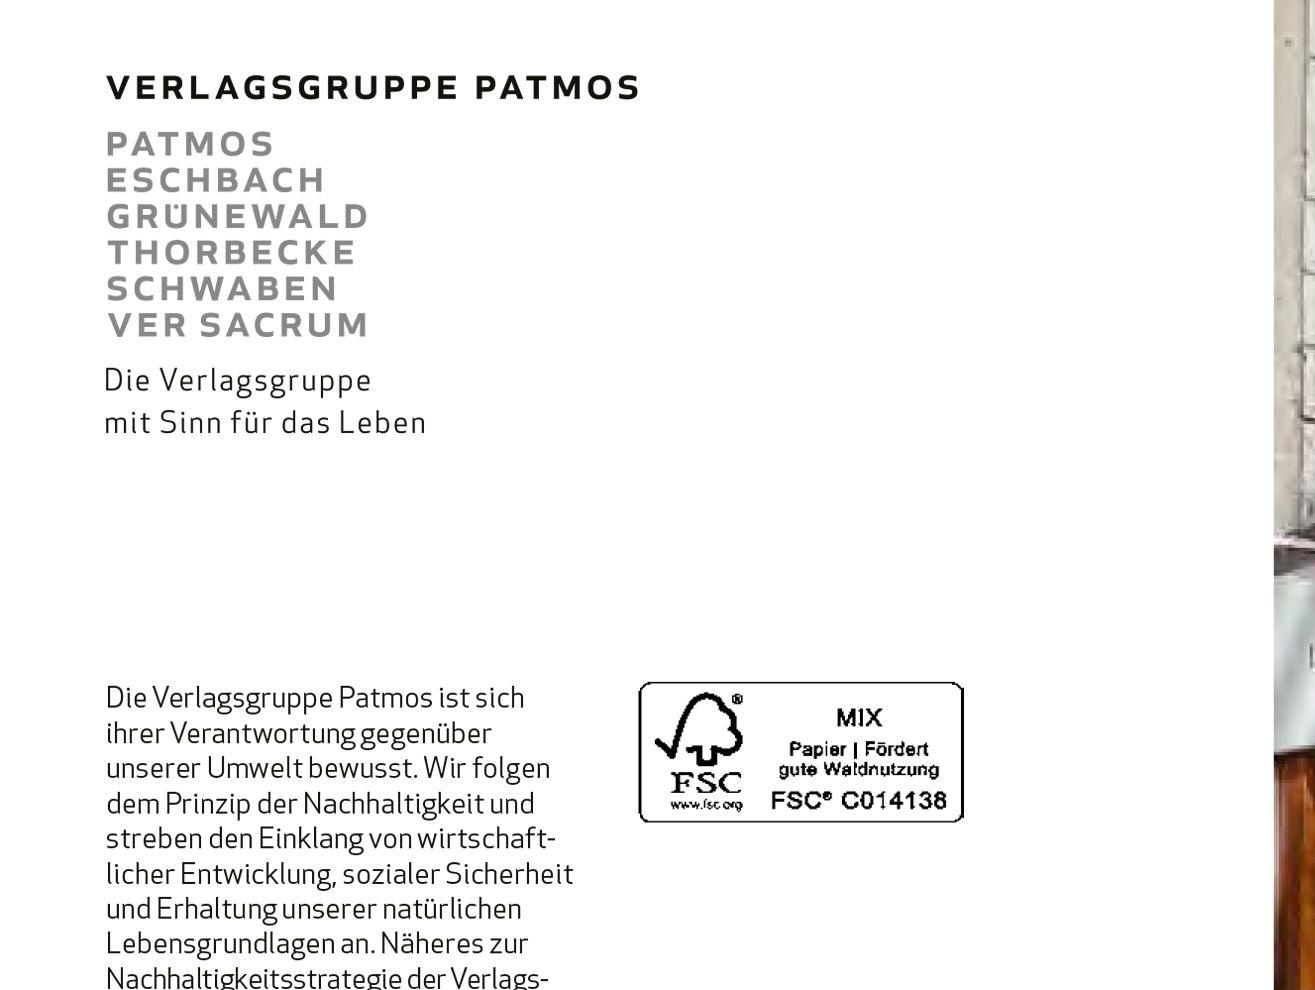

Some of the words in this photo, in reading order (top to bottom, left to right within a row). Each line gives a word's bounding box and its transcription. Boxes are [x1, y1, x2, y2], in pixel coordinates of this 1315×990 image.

[105, 74, 457, 101] VERLAGSGRUPPE
[475, 74, 639, 101] PATMOS
[107, 131, 272, 157] PATMOS
[107, 167, 322, 193] ESCHBACH
[107, 203, 367, 229] GRÜNEWALD
[107, 239, 354, 265] THORBECKE
[107, 276, 335, 301] SCHWABEN
[107, 312, 186, 338] VER
[200, 312, 366, 338] SACRUM
[105, 367, 150, 392] Die
[159, 367, 371, 399] Verlagsgruppe
[105, 410, 151, 434] mit
[160, 409, 221, 434] Sinn
[230, 409, 273, 434] für
[281, 409, 330, 434] das
[340, 409, 425, 434] Leben
[107, 685, 147, 709] Die
[151, 685, 333, 716] Verlagsgruppe
[339, 685, 433, 709] Patmos
[439, 687, 471, 709] ist
[475, 685, 524, 709] sich
[836, 707, 883, 728] MIX
[107, 720, 166, 744] ihrer
[169, 720, 357, 751] Verantwortung
[360, 720, 493, 751] gegenüber
[789, 740, 848, 760] Papier
[865, 740, 929, 758] Fördert
[107, 762, 201, 779] unserer
[208, 755, 304, 779] Umwelt
[309, 755, 418, 779] bewusst.
[423, 755, 467, 779] Wir
[471, 755, 550, 786] folgen
[670, 771, 742, 794] FSC
[778, 762, 818, 781] gute
[823, 761, 940, 781] Waldnutzung
[670, 798, 744, 813] www.fsc.org
[771, 790, 833, 810] FSC®
[841, 790, 947, 810] C014138
[106, 825, 202, 850] streben
[209, 825, 253, 849] den
[259, 825, 365, 856] Einklang
[368, 832, 412, 849] von
[417, 825, 556, 850] wirtschaft-
[107, 861, 176, 885] licher
[181, 861, 337, 892] Entwicklung,
[343, 861, 441, 885] sozialer
[446, 861, 574, 885] Sicherheit
[107, 896, 151, 920] und
[157, 896, 279, 927] Erhaltung
[282, 903, 378, 920] unserer
[383, 896, 521, 920] natürlichen
[107, 930, 335, 961] Lebensgrundlagen
[340, 937, 376, 955] an.
[381, 930, 484, 955] Näheres
[489, 937, 529, 955] zur
[407, 966, 447, 990] der
